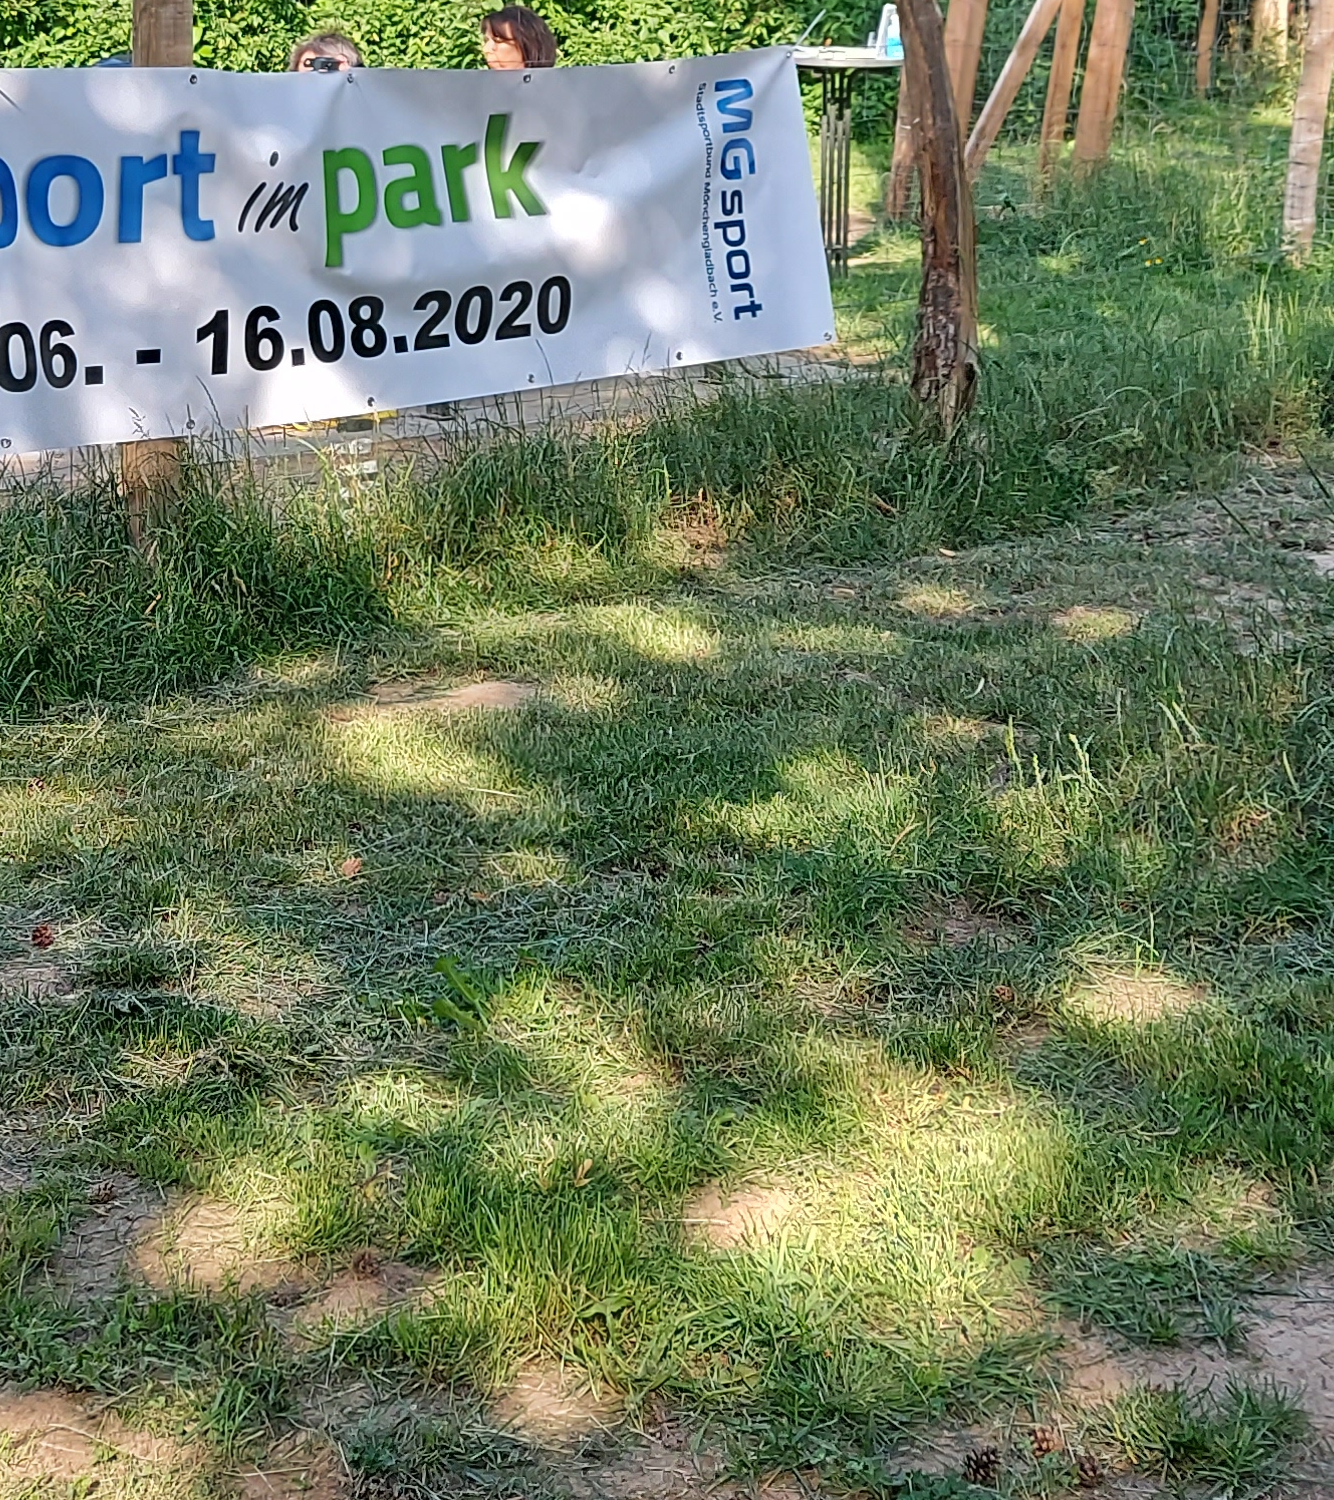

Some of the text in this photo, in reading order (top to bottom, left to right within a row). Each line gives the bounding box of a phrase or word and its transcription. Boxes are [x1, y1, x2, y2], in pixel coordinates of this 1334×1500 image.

[237, 150, 311, 234] im
[322, 112, 549, 269] park
[695, 82, 723, 324] Stadtsportbund Mönchengladbach e.V.
[712, 77, 764, 321] MG sport
[135, 346, 163, 366] -
[195, 274, 573, 377] 16.08.2020
